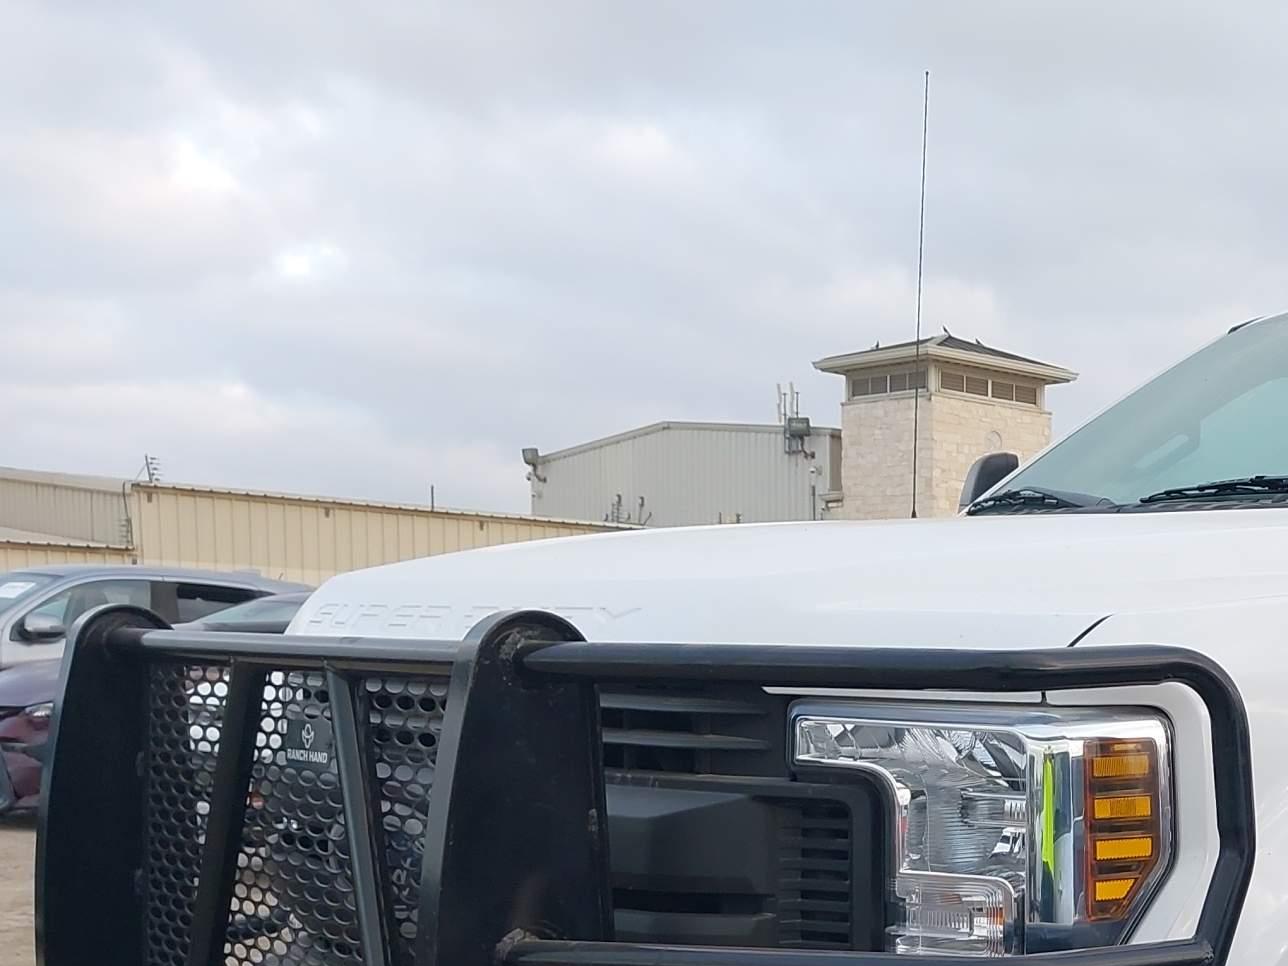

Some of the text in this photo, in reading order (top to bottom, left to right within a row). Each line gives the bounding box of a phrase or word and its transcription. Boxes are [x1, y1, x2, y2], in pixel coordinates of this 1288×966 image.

[308, 603, 455, 632] SUPER
[287, 748, 328, 764] RANCH HAND
